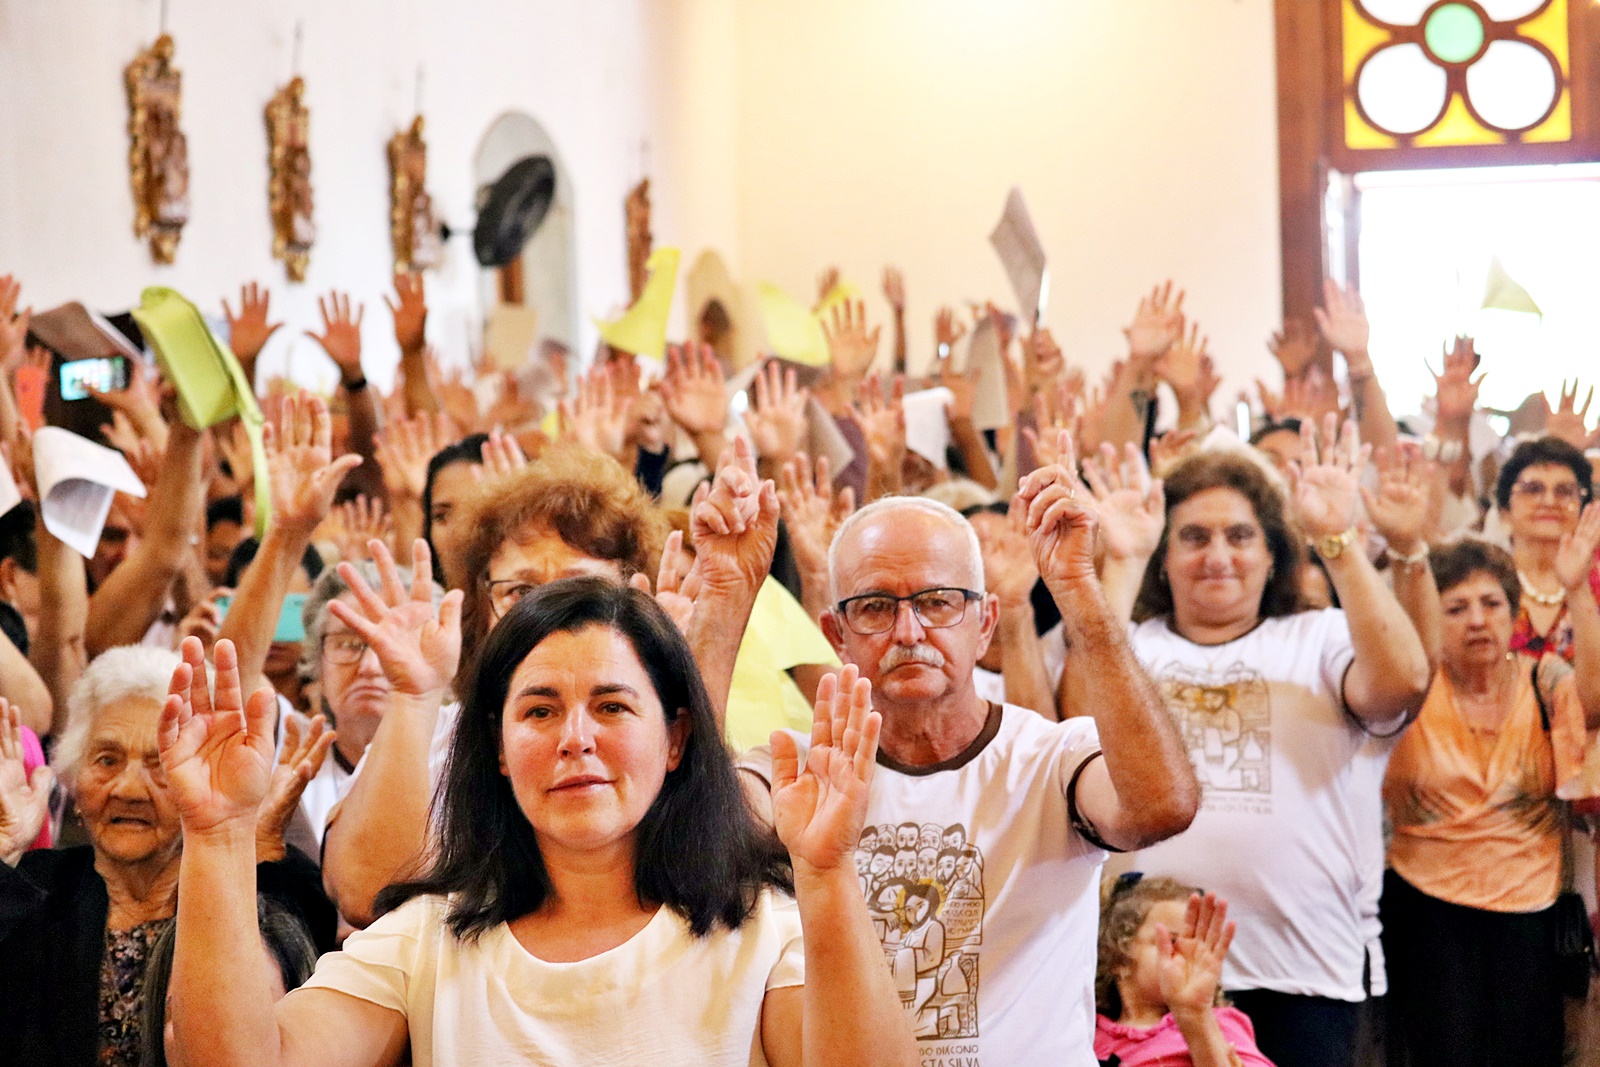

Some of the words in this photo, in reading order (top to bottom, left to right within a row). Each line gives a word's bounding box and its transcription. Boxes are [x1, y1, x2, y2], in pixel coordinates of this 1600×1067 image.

[918, 1047, 934, 1056] DO
[936, 1044, 979, 1056] DIÁCONO
[921, 1057, 944, 1067] STA
[948, 1057, 980, 1067] SILVA
